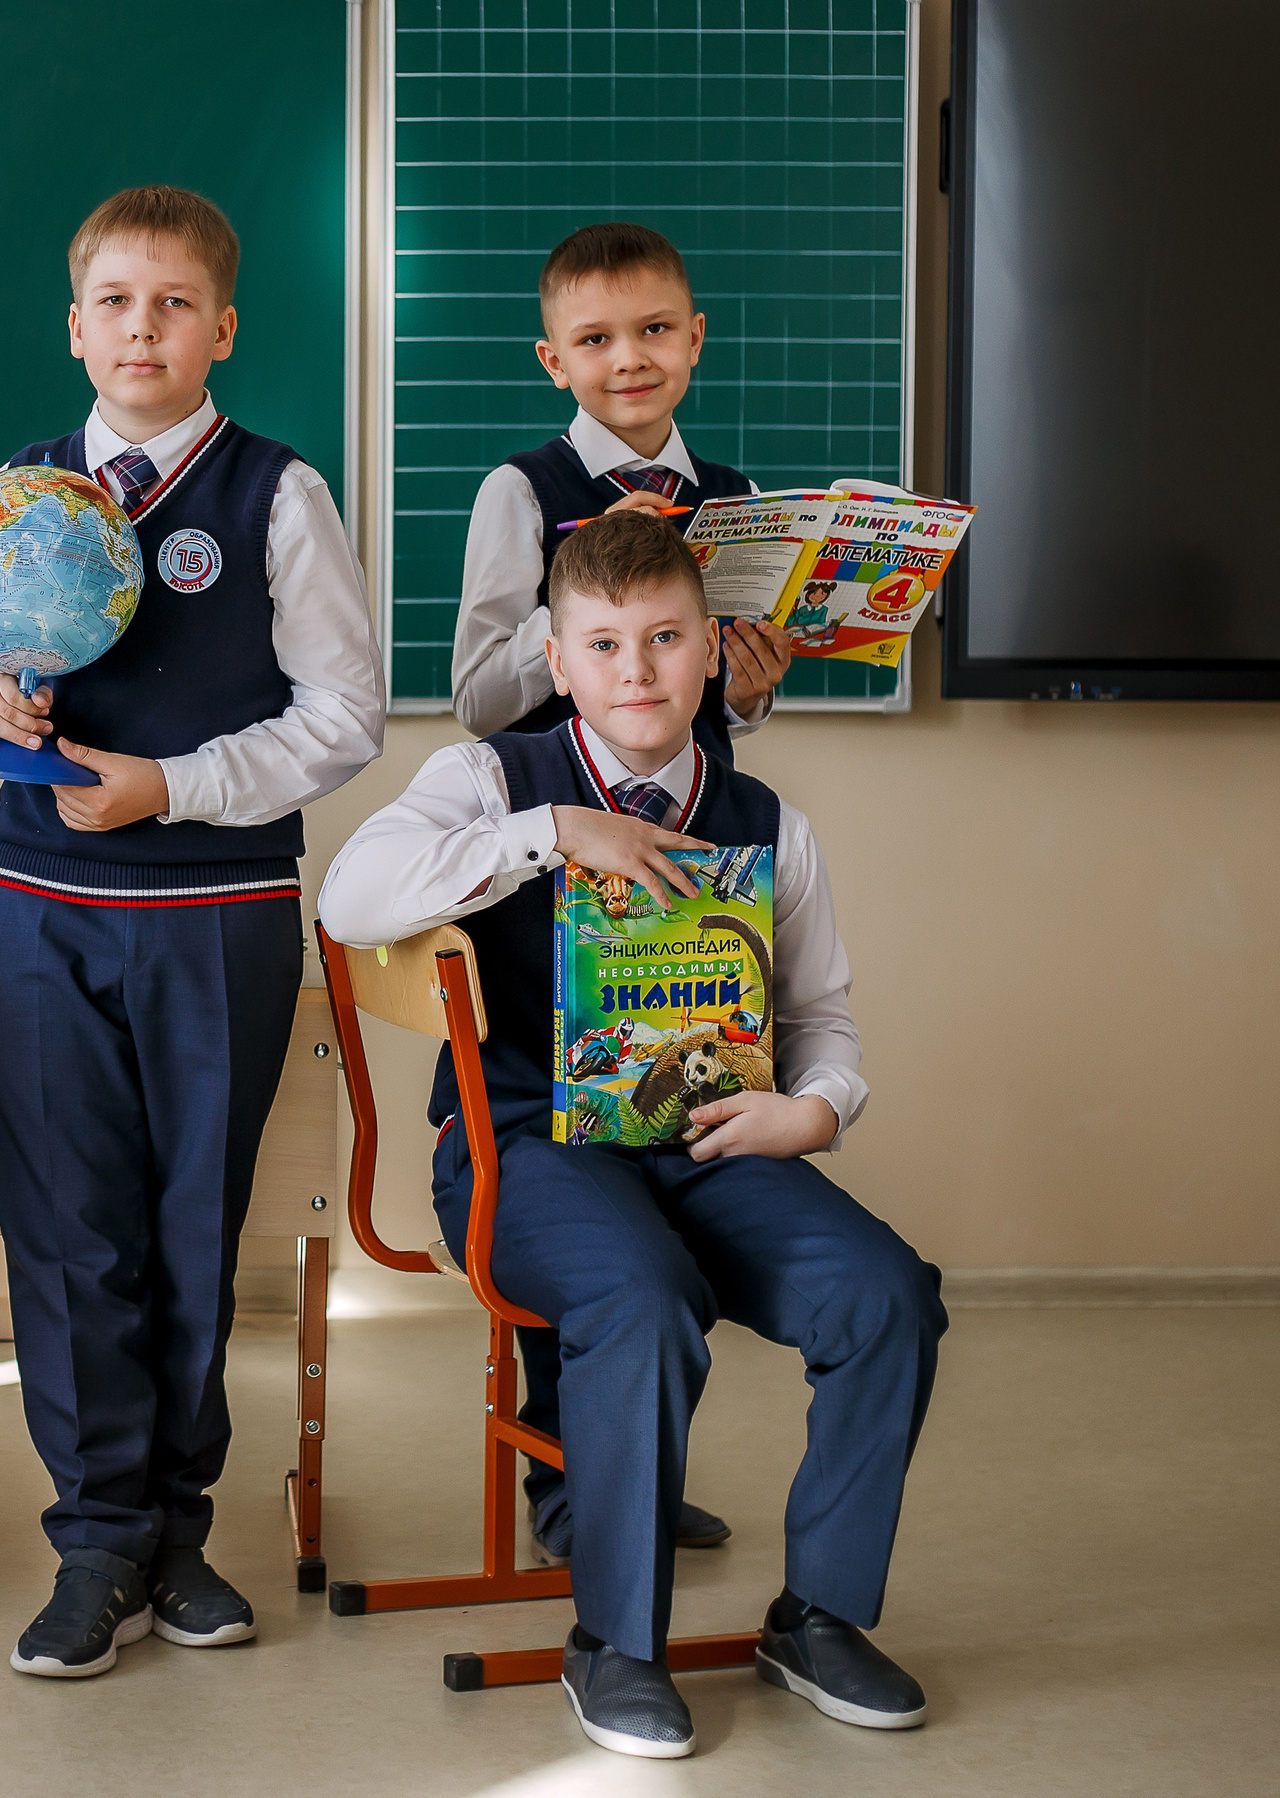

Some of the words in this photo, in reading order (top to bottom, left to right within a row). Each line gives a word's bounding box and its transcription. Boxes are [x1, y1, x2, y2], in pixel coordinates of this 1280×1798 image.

[698, 512, 795, 528] ОЛИМПИАДЫ
[922, 510, 956, 521] ФГОС
[691, 524, 792, 540] МАТЕМАТИКЕ
[160, 537, 175, 561] ЦЕНТР
[189, 532, 220, 570] ОБРАЗОВАНИЯ
[815, 544, 944, 570] МАТЕМАТИКЕ
[176, 549, 204, 573] 15
[169, 577, 205, 591] ВЫСОТА
[873, 578, 914, 610] 4
[857, 607, 912, 623] КЛАСС
[599, 938, 741, 959] ЭНЦИКЛОПЕДИЯ
[598, 960, 741, 978] НЕОБХОДИМЫХ
[599, 972, 741, 1014] ЗНАНИЙ
